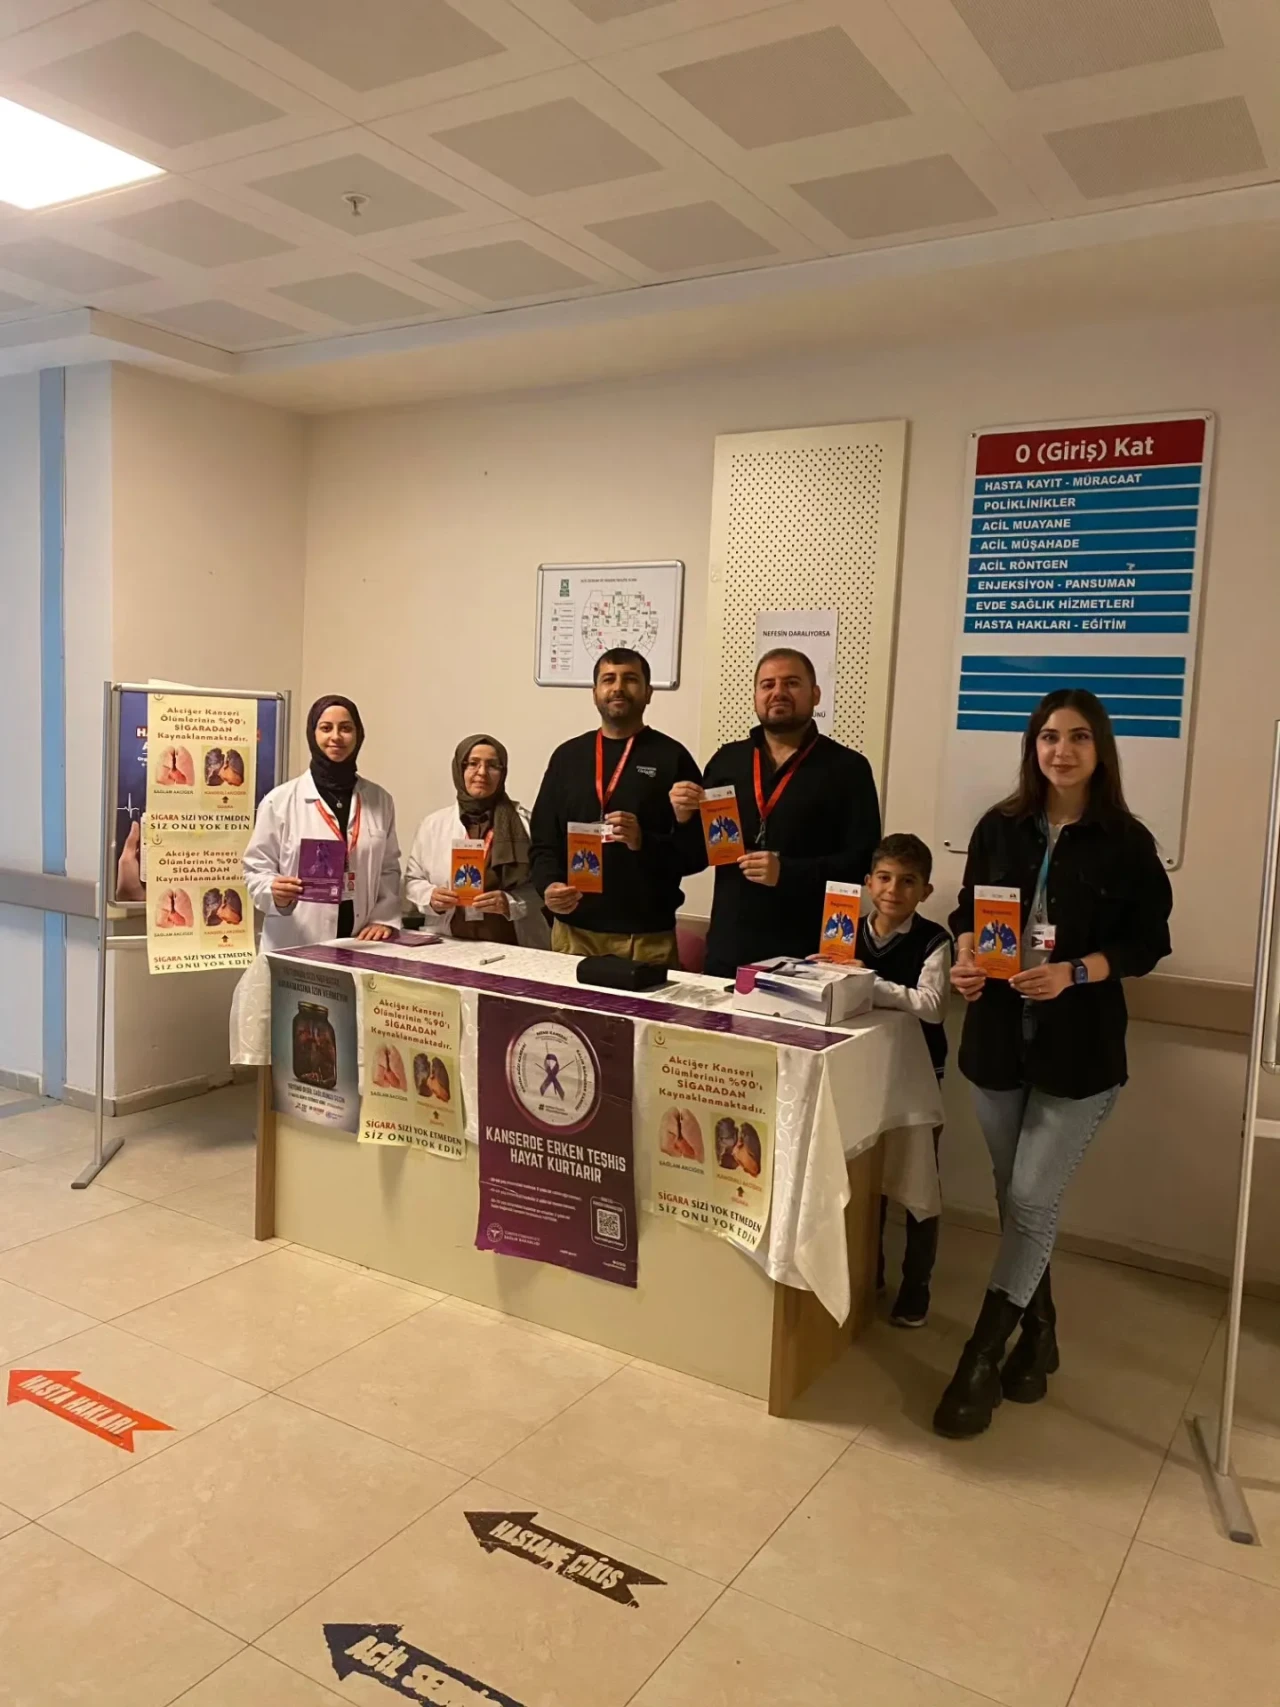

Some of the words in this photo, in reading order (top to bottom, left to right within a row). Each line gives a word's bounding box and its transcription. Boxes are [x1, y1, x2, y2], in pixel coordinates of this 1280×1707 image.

[1037, 439, 1107, 464] (Giriş)
[1114, 436, 1155, 457] Kat
[985, 480, 1023, 490] HASTA
[1026, 478, 1062, 489] KAYIT
[1073, 473, 1142, 487] MÜRACAAT
[984, 496, 1076, 511] POLİKLİNİKLER
[982, 520, 1009, 531] ACİL
[1013, 519, 1071, 529] MUAYANE
[980, 540, 1007, 551] ACİL
[1011, 538, 1079, 551] MÜŞAHADE
[979, 560, 1006, 571] ACİL
[1010, 559, 1068, 570] RÖNTGEN
[978, 578, 1054, 590] ENJEKSİYON
[1065, 578, 1136, 588] PANSUMAN
[976, 600, 1006, 610] EVDE
[1010, 598, 1055, 609] SAĞLIK
[1059, 597, 1135, 609] HİZMETLERİ
[974, 620, 1013, 630] HASTA
[1017, 620, 1071, 629] HAKLARI
[1082, 618, 1126, 629] EĞİTİM
[167, 707, 202, 715] Akciğer
[160, 715, 215, 724] Ölümlerinin
[174, 723, 232, 732] SİGARADAN
[151, 813, 179, 821] SİGARA
[165, 850, 200, 858] Akciğer
[172, 865, 230, 873] SİGARADAN
[154, 954, 182, 963] SİGARA
[218, 951, 253, 959] ETMEDEN
[176, 962, 200, 970] ONU
[373, 1006, 422, 1023] Ölümlerinin
[379, 999, 409, 1011] Akciğer
[412, 1005, 444, 1018] Kanseri
[385, 1018, 437, 1036] SİGARADAN
[661, 1064, 726, 1084] Ölümlerinin
[669, 1056, 709, 1070] Akciğer
[712, 1063, 754, 1079] Kanseri
[677, 1079, 746, 1099] SİGARADAN
[658, 1087, 767, 1115] Kaynaklanmaktadır.
[364, 1130, 384, 1140] SİZ
[388, 1133, 413, 1144] ONU
[415, 1138, 435, 1149] YOK
[366, 1119, 396, 1130] SİGARA
[398, 1123, 413, 1133] SİZİ
[414, 1127, 429, 1136] YOK
[430, 1131, 462, 1146] ETMEDEN
[486, 1126, 545, 1152] KANSERDE
[547, 1139, 584, 1161] ERKEN
[511, 1148, 543, 1169] HAYAT
[547, 1156, 602, 1184] KURTARIR
[658, 1190, 689, 1206] SİGARA
[691, 1199, 709, 1211] SİZİ
[710, 1204, 729, 1217] YOK
[730, 1211, 762, 1234] ETMEDEN
[658, 1203, 678, 1215] SİZ
[681, 1209, 709, 1223] ONU
[713, 1217, 735, 1233] YOK
